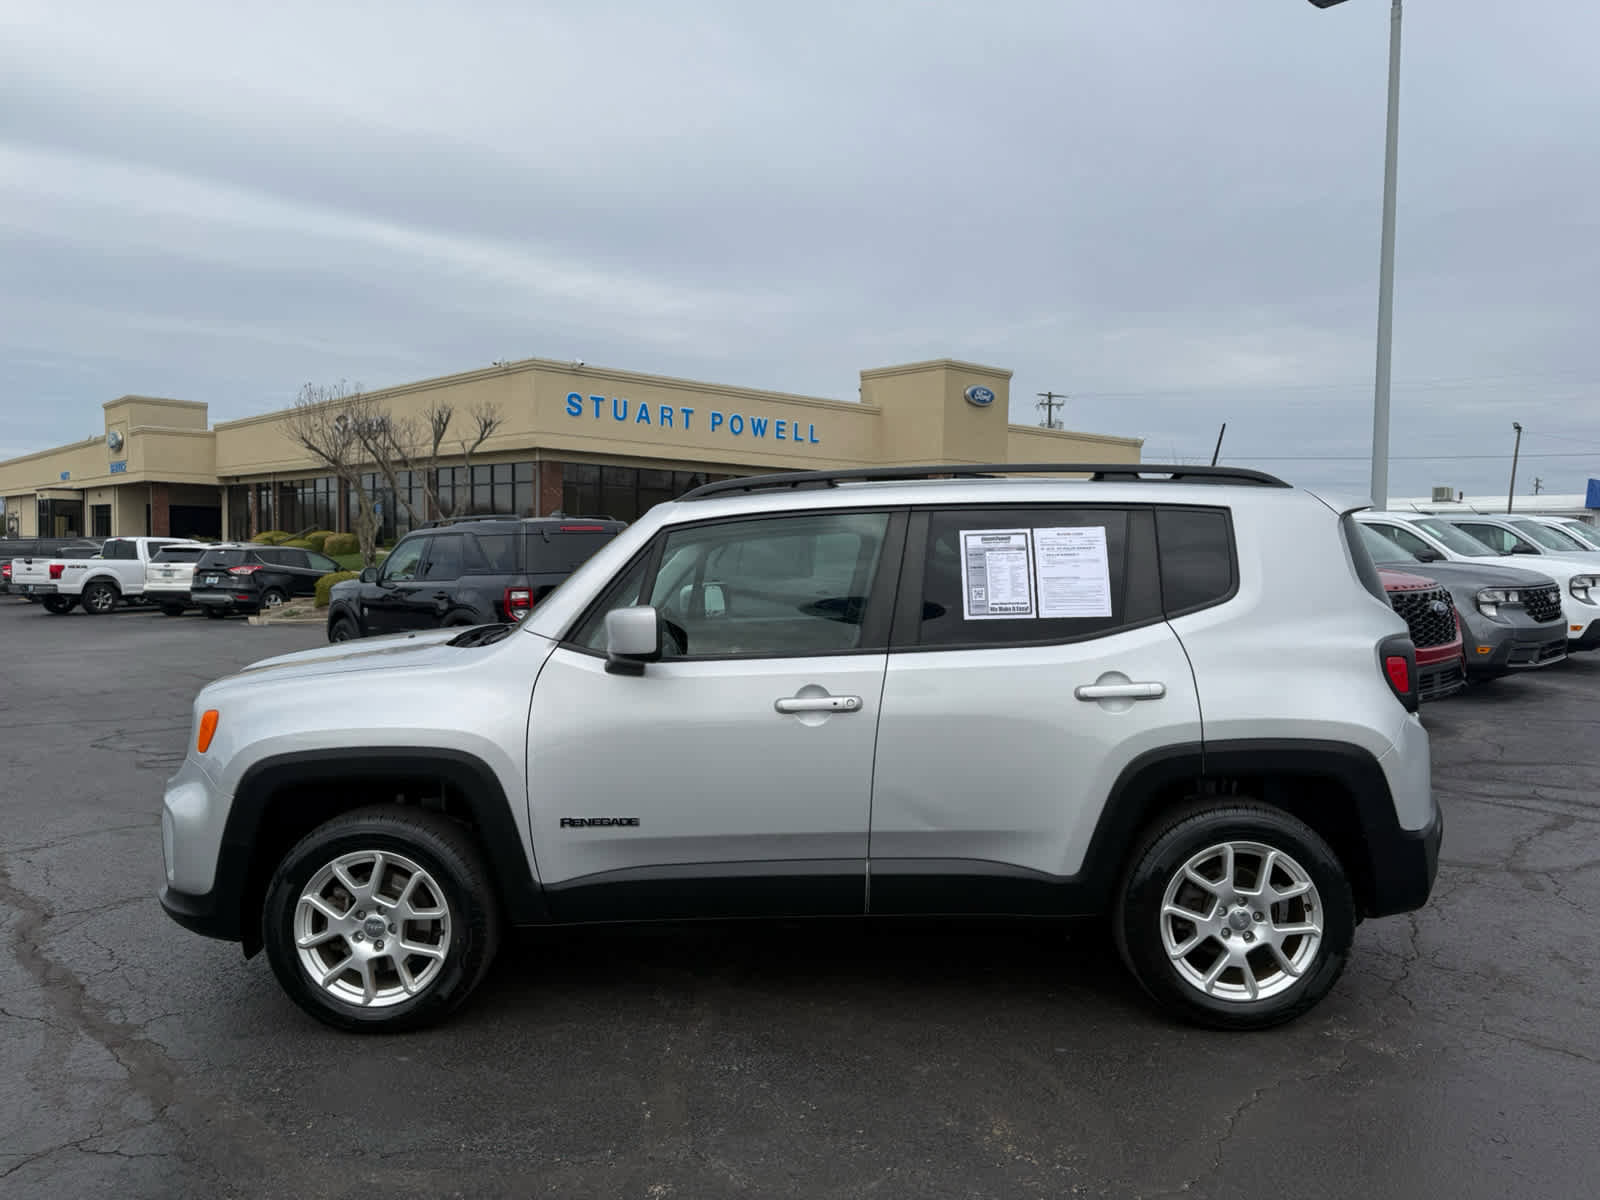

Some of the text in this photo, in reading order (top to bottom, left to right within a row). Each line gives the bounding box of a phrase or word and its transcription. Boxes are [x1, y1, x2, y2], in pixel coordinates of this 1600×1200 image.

[566, 393, 820, 444] STUART POWELL
[560, 817, 640, 828] RENEGADE
